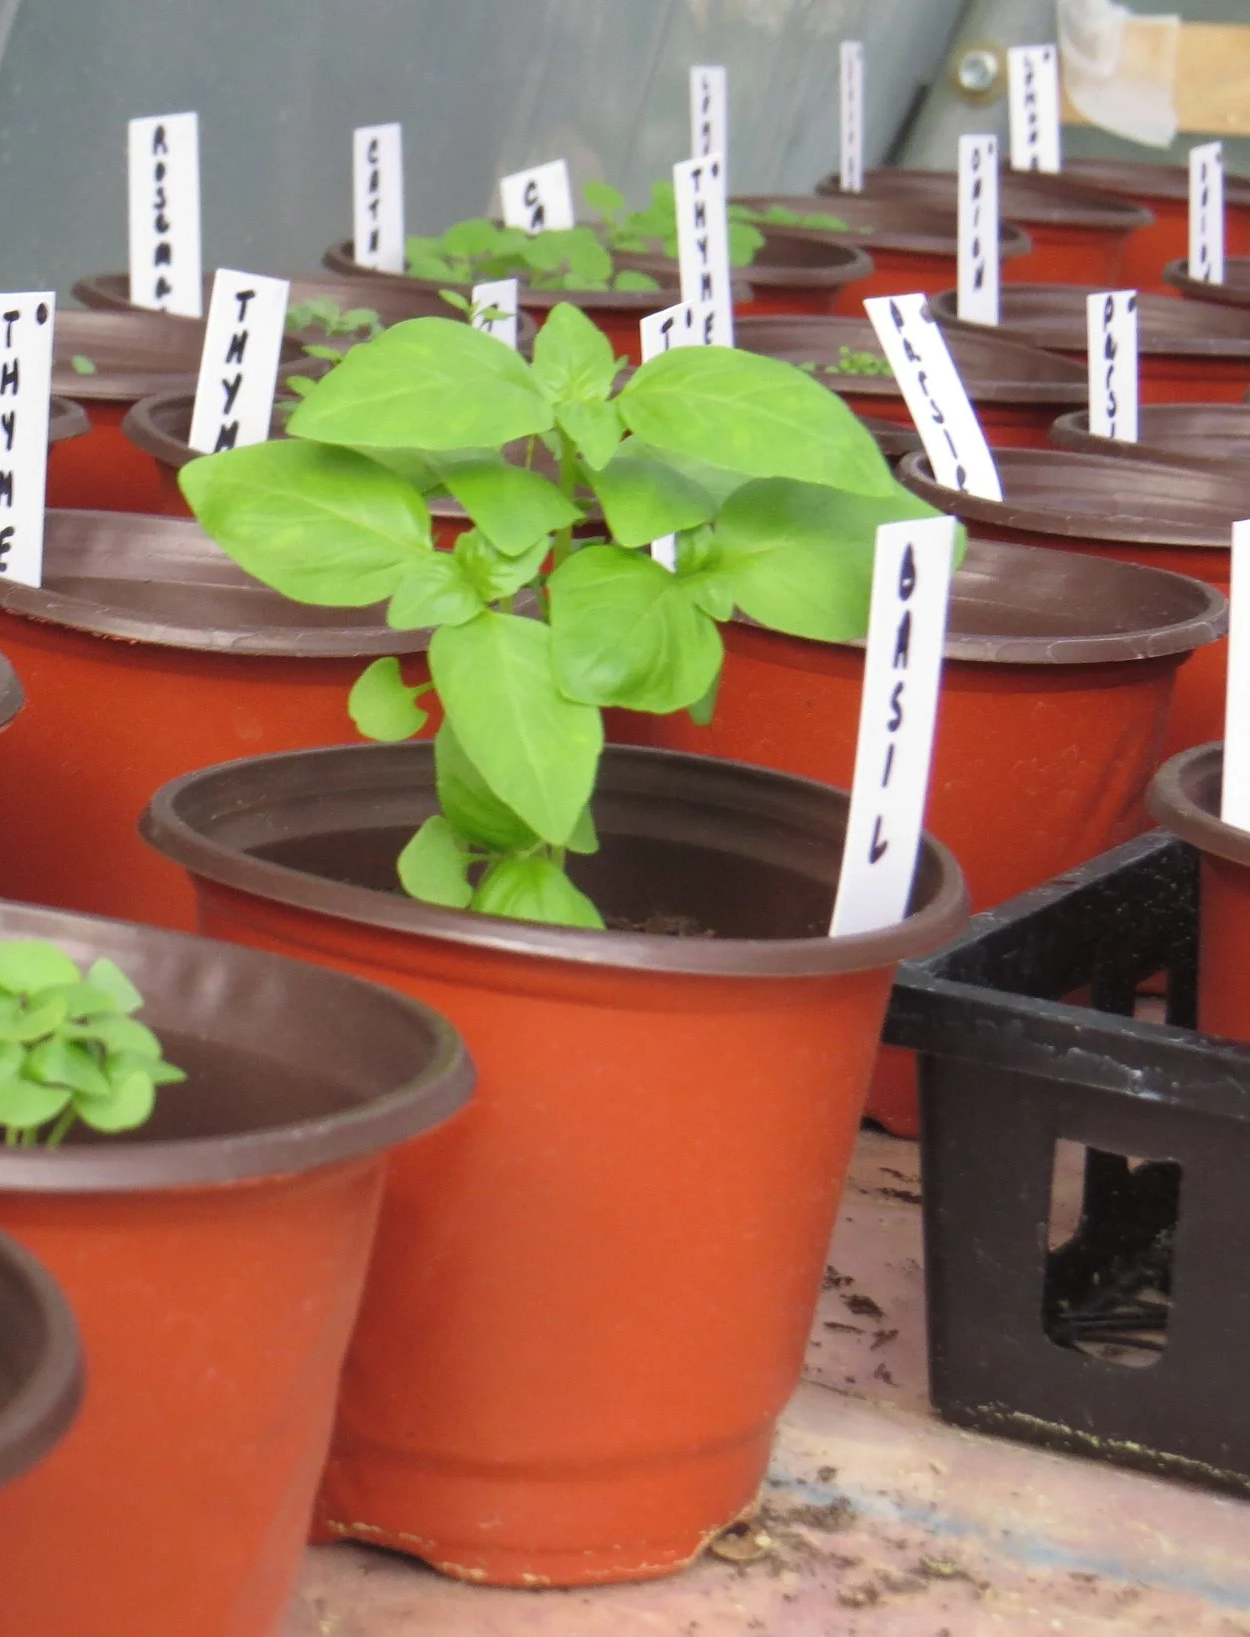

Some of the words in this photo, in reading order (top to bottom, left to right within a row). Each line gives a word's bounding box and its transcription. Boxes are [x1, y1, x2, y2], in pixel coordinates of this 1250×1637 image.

[367, 136, 380, 268] CATN
[691, 167, 715, 346] THYME
[868, 542, 916, 866] BASIL
